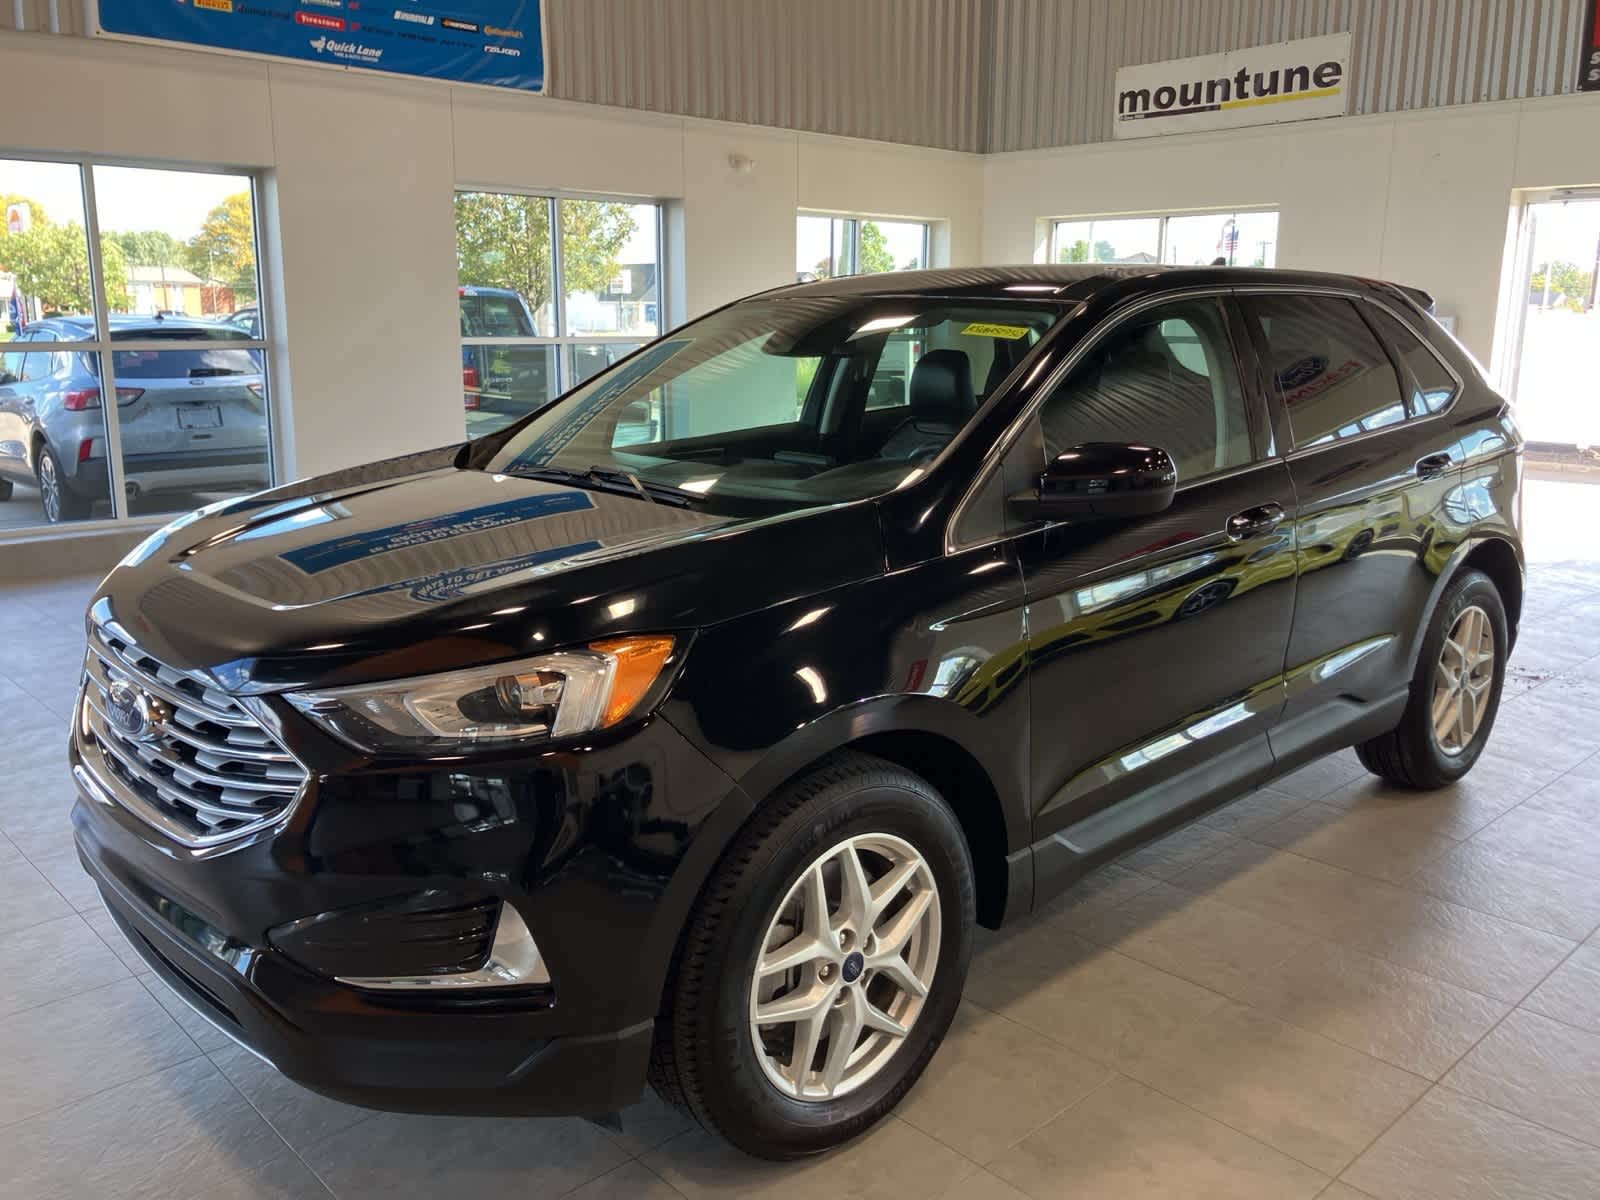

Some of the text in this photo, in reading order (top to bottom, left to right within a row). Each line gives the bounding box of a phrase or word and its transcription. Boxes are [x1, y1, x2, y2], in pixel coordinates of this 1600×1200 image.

[326, 40, 356, 53] Quick
[357, 44, 383, 57] Lane
[1118, 61, 1343, 114] mountune
